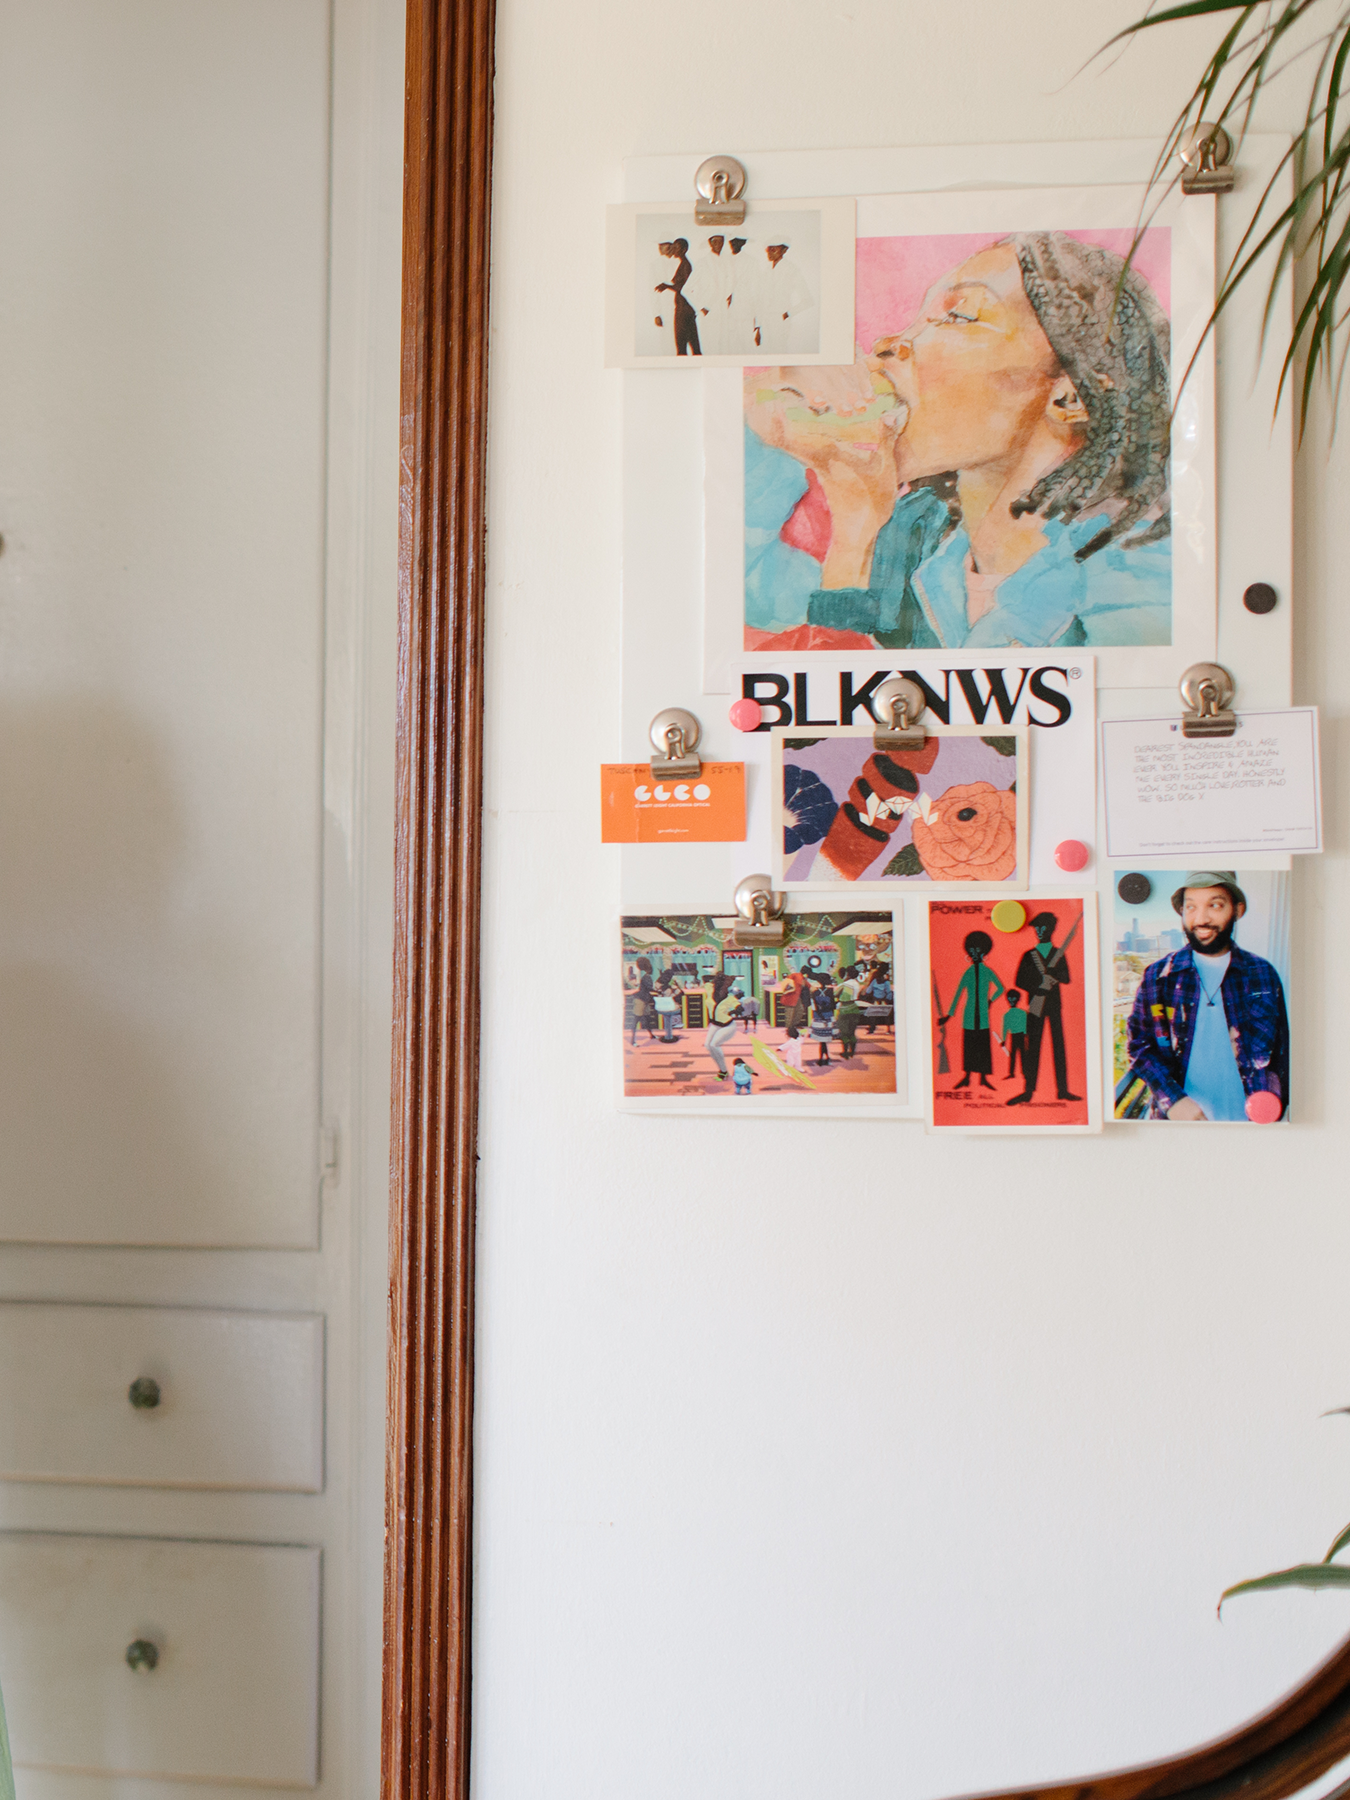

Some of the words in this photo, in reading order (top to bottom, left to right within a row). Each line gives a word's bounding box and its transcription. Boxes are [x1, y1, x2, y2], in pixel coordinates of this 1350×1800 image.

[1134, 744, 1175, 753] DEAREST
[1257, 738, 1279, 748] ARE
[1135, 754, 1150, 763] THE
[1153, 753, 1178, 762] MOST
[1183, 750, 1244, 761] INCREDIBLE
[1247, 749, 1279, 757] HUMAN
[1161, 763, 1179, 771] YOU
[1183, 761, 1225, 771] INSPIRE
[1238, 759, 1273, 769] AMAZE
[1135, 774, 1151, 783] ME
[1153, 773, 1181, 782] EVERY
[1184, 771, 1219, 781] SINGLE
[1243, 768, 1285, 778] HONESTLY
[1165, 783, 1178, 792] SO
[1180, 781, 1207, 791] MUCH
[1267, 778, 1287, 787] AND
[1138, 794, 1153, 803] THE
[1156, 793, 1175, 803] BIG
[1178, 793, 1195, 802] DOG
[931, 905, 983, 914] POWER
[936, 1091, 972, 1100] FREE
